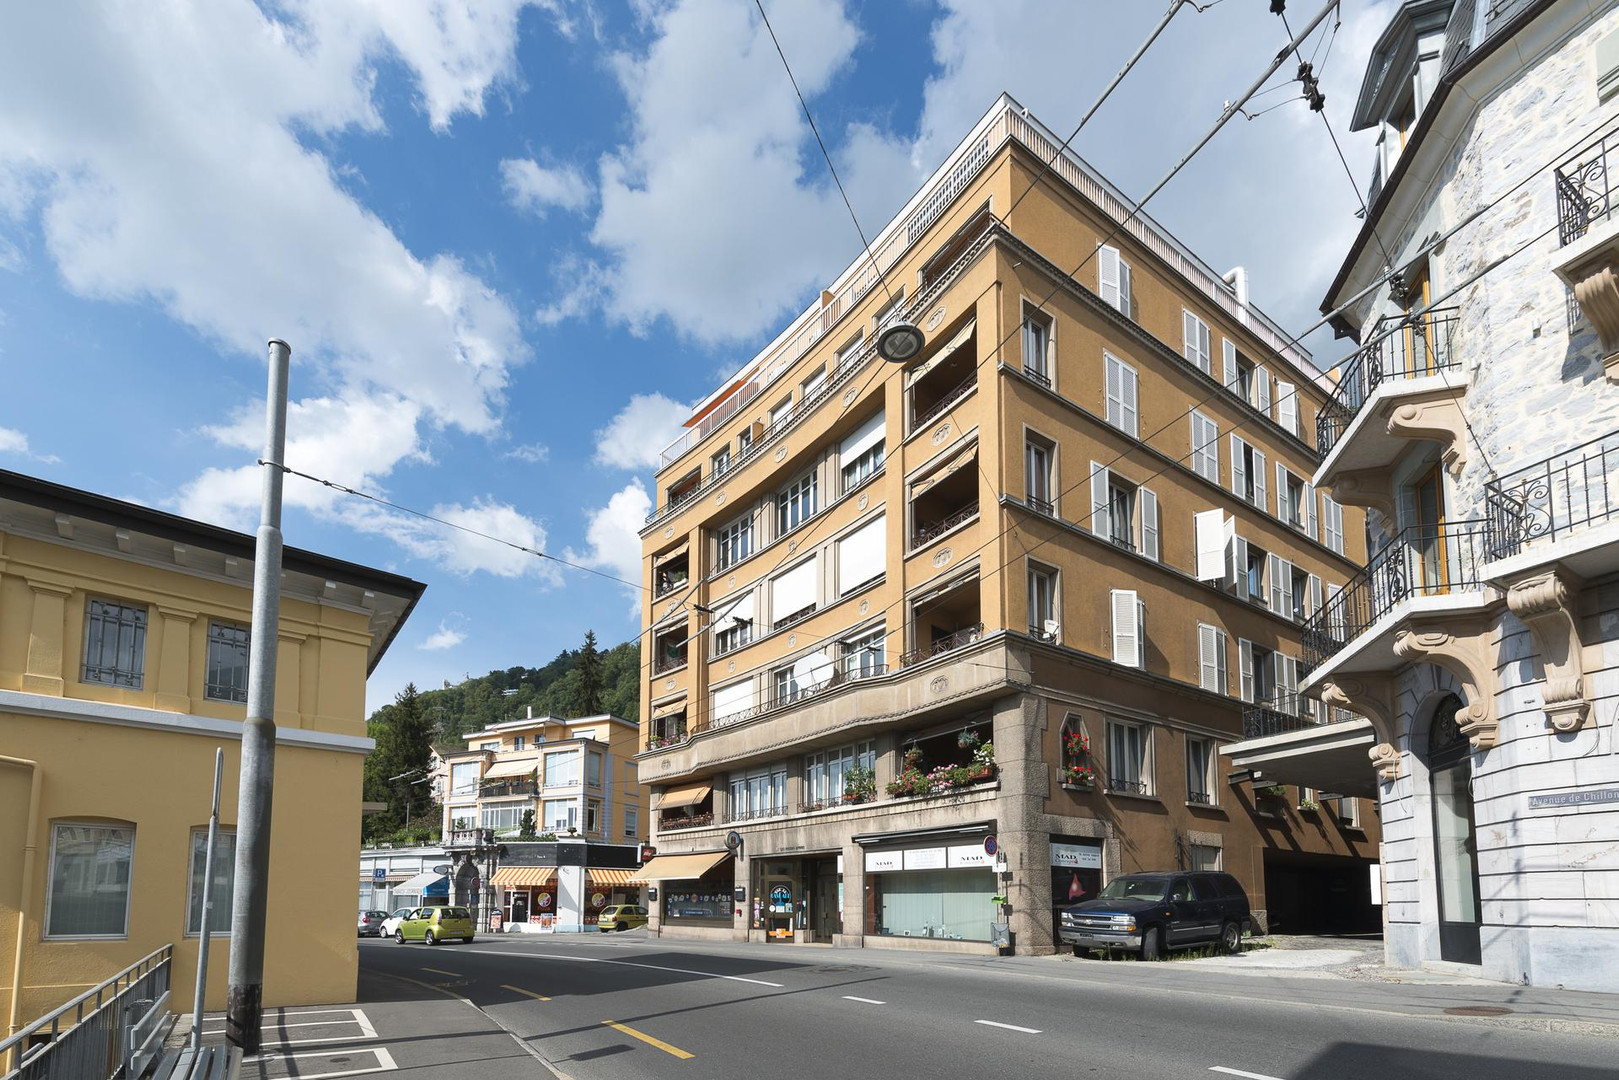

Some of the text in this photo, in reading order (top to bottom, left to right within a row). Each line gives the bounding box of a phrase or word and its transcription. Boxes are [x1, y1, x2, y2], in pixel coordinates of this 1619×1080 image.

[1532, 790, 1619, 806] Avenue de Chillon
[377, 869, 383, 877] P
